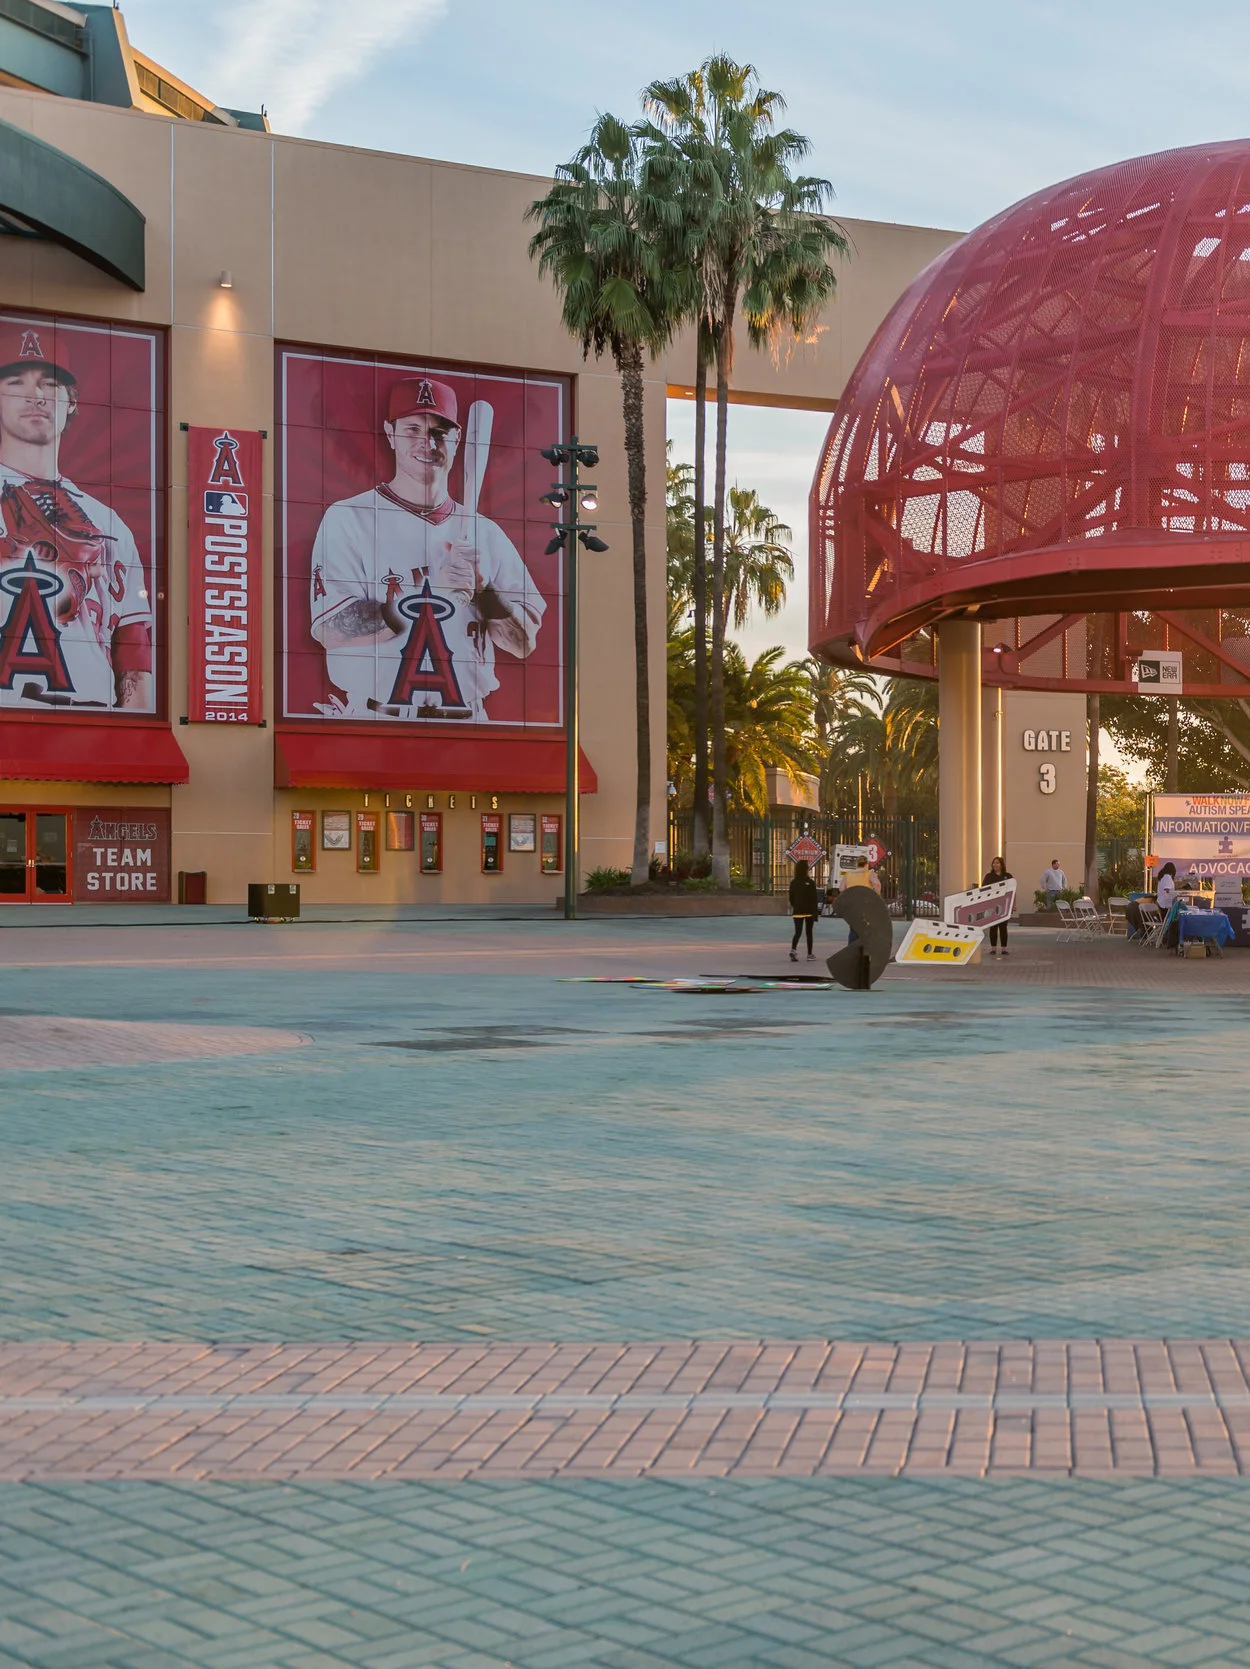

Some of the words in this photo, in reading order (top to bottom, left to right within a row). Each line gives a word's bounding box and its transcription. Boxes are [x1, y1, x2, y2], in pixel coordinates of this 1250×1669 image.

[208, 430, 245, 487] A
[205, 517, 248, 705] POSTSEASON
[387, 577, 467, 708] A
[205, 711, 248, 722] 2014
[1023, 729, 1071, 752] GATE
[1039, 763, 1056, 794] 3
[364, 793, 499, 809] TICKETS
[1189, 805, 1227, 815] AUTISM
[1192, 796, 1219, 806] WALK
[1220, 796, 1244, 806] NOW
[88, 815, 157, 841] ANGELS
[93, 848, 152, 867] TEAM
[87, 872, 157, 891] STORE
